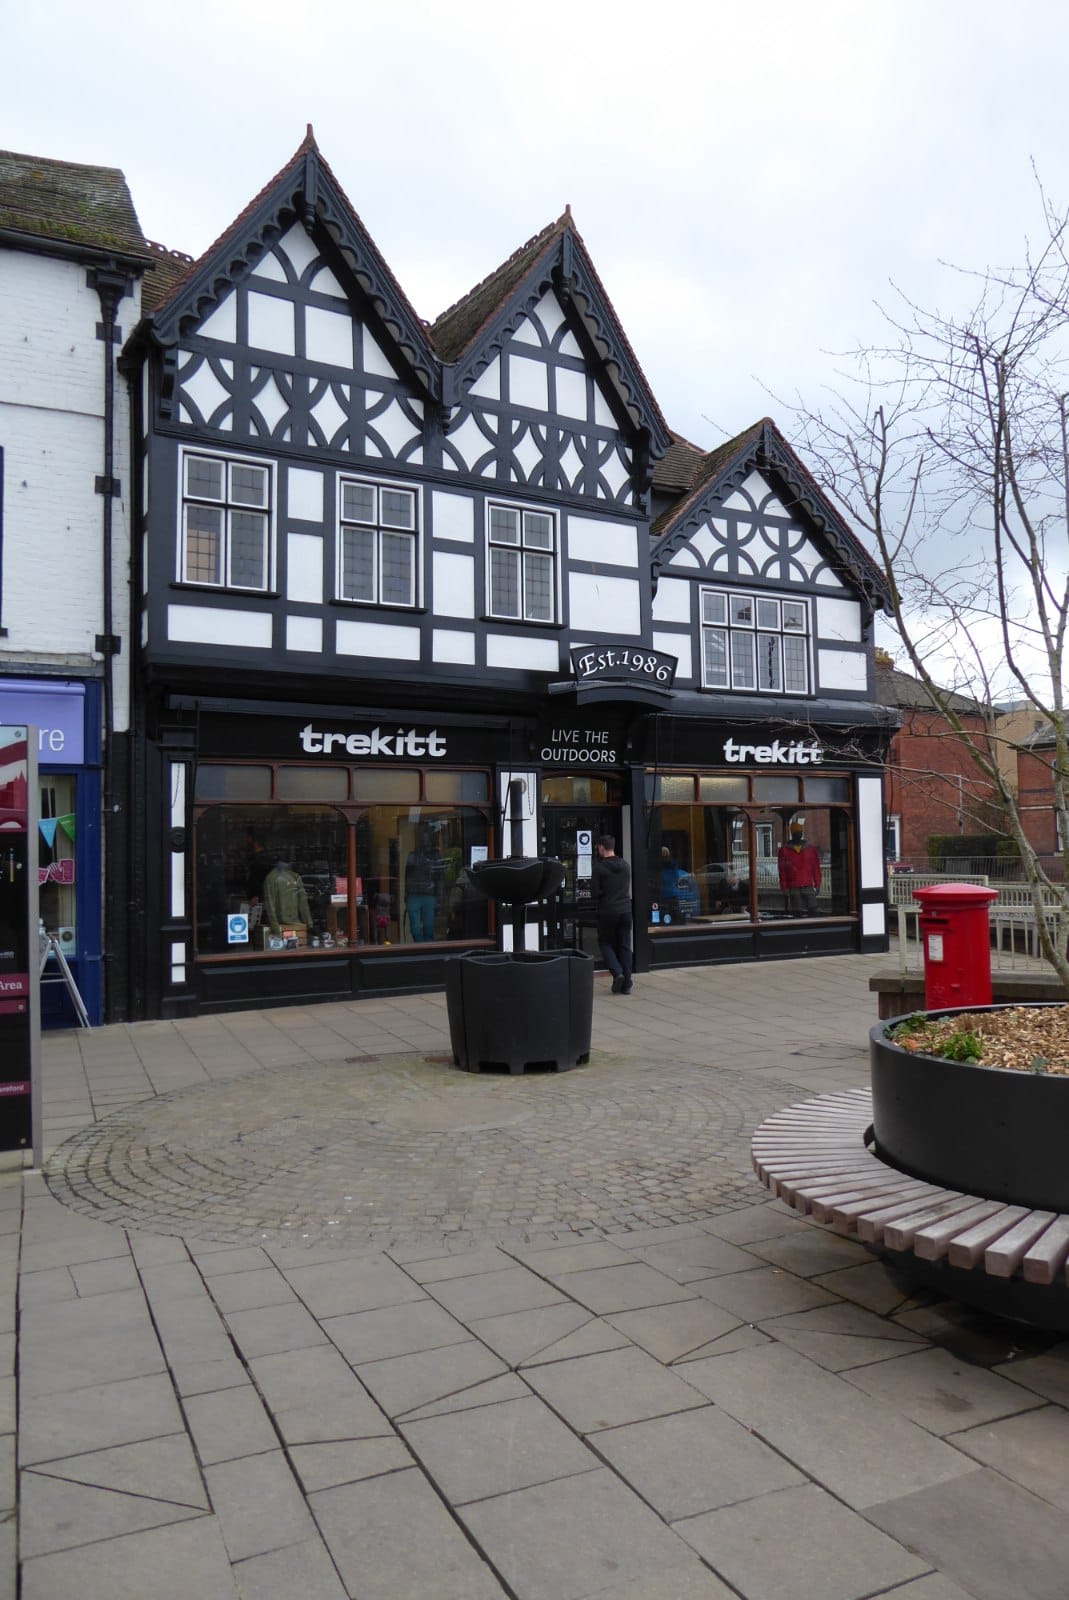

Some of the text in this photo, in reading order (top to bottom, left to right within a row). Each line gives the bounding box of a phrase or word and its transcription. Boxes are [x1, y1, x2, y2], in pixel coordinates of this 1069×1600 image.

[299, 723, 447, 757] trekitt
[551, 729, 609, 744] LIVE THE
[540, 747, 616, 763] OUTDOORS
[723, 737, 823, 765] trekitt
